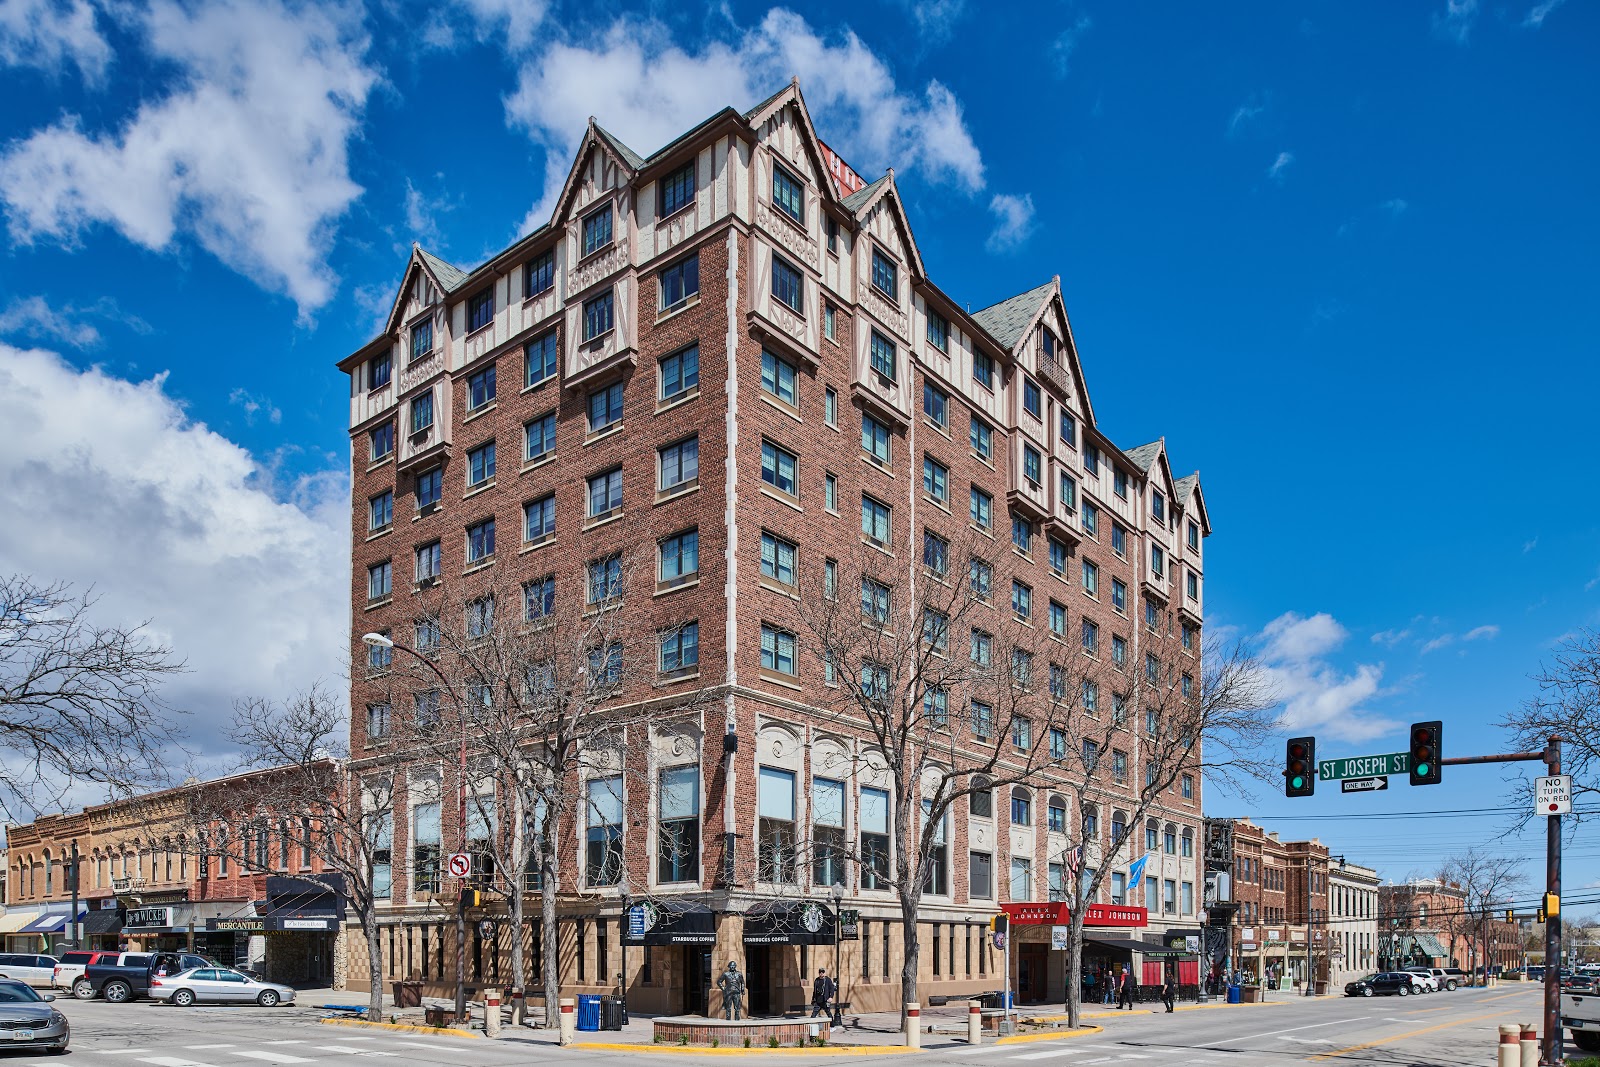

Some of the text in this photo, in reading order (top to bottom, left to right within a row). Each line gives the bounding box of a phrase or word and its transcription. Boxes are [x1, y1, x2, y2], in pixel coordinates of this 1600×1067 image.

[1323, 754, 1407, 778] ST JOSEPH ST
[1545, 778, 1561, 787] NO
[1543, 787, 1564, 795] TURN
[1553, 794, 1569, 802] RED
[140, 909, 167, 921] WICKED
[1108, 911, 1141, 921] JOHNSON
[217, 921, 263, 930] MERCANTILE
